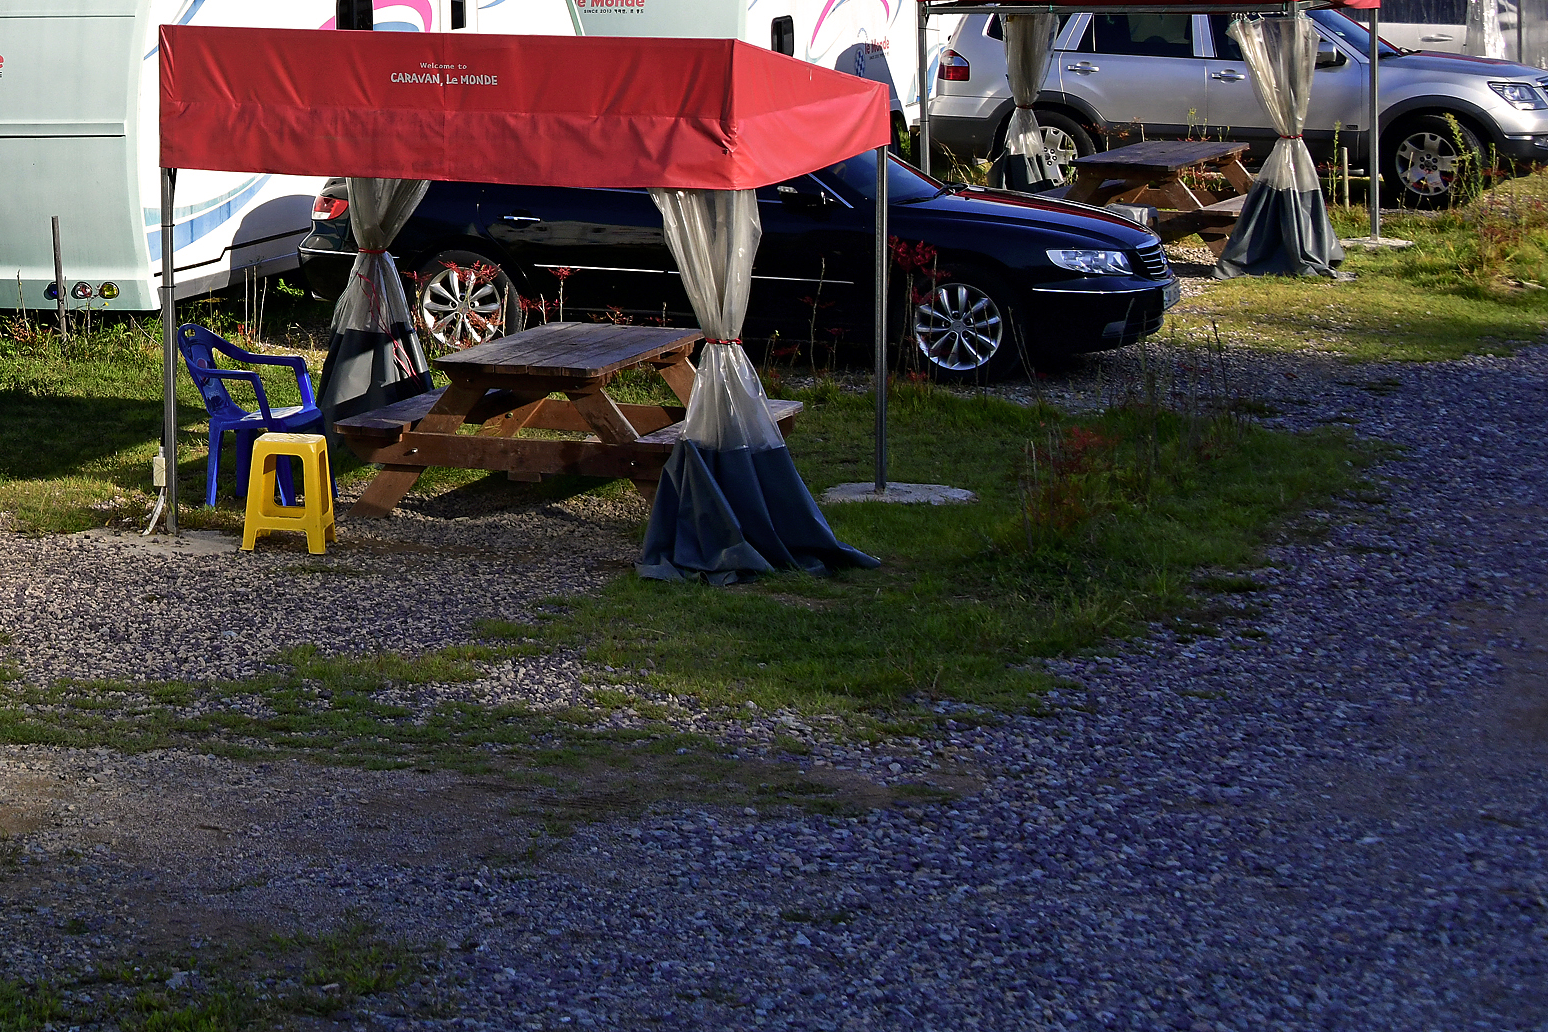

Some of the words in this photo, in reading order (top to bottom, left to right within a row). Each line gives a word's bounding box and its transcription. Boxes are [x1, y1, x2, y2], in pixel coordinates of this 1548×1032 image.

[419, 62, 455, 70] Welcome
[390, 72, 444, 87] CARAVAN,
[446, 73, 458, 85] Le
[460, 74, 498, 86] MONDE
